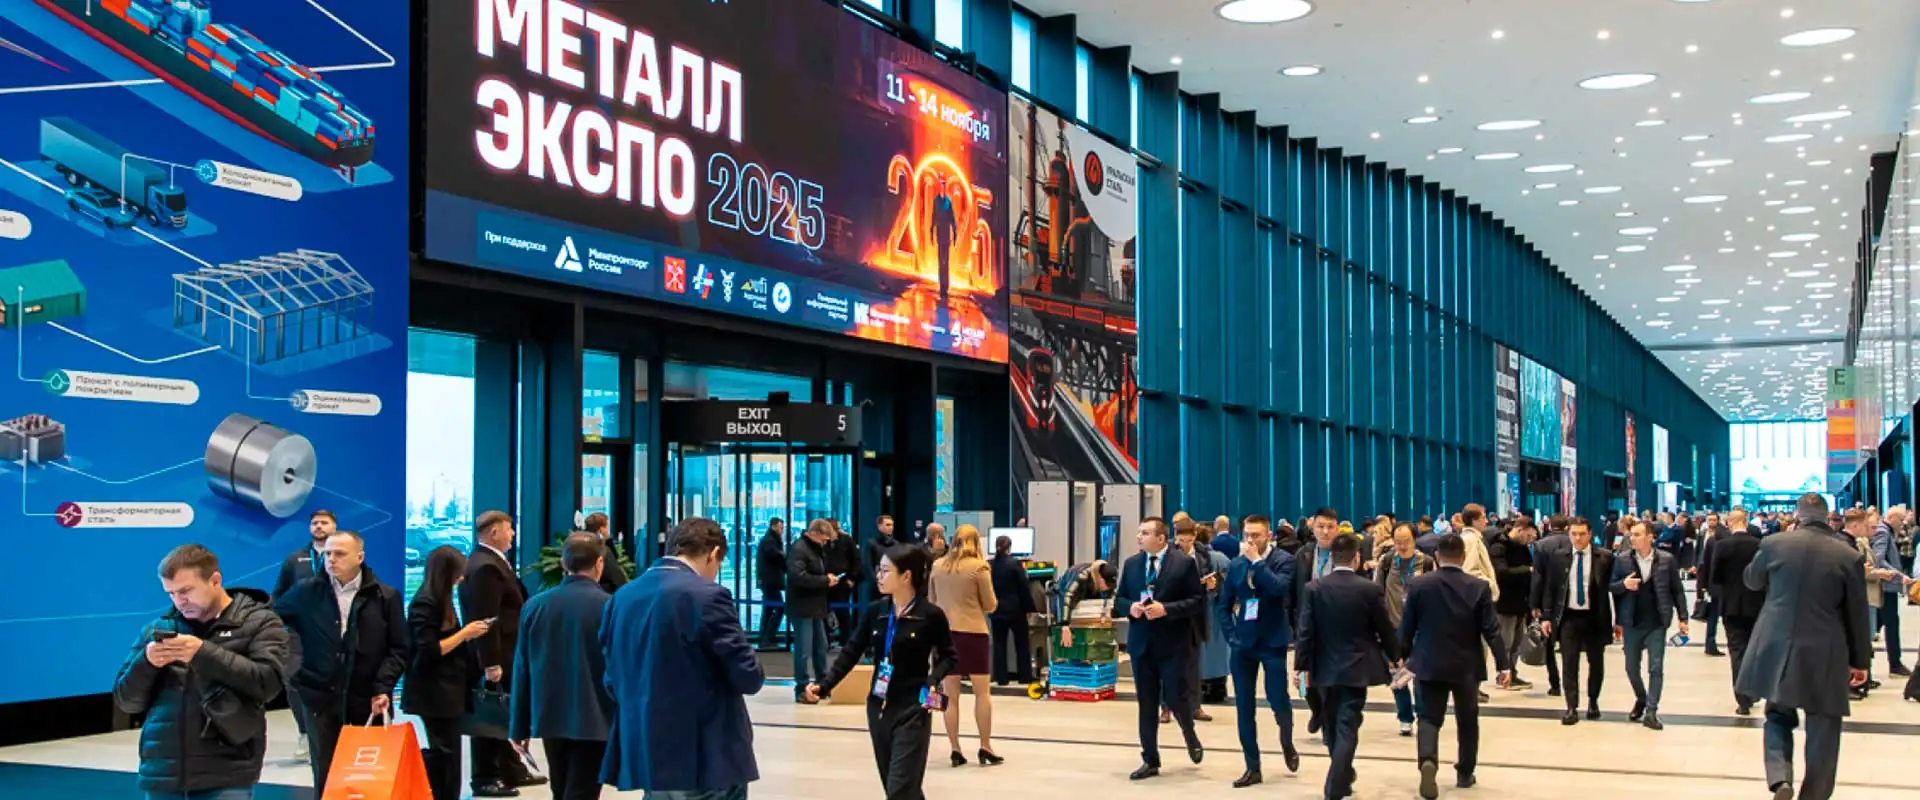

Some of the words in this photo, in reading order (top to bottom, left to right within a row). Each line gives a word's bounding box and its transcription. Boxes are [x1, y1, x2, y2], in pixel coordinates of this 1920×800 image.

[476, 0, 743, 143] МЕТАЛЛ
[886, 73, 905, 104] 11
[919, 87, 938, 118] 14
[941, 103, 991, 142] ноября
[475, 77, 698, 219] ЭКСПО
[707, 151, 826, 252] 2025
[485, 230, 502, 245] При
[588, 247, 650, 270] Минпромторг
[588, 258, 623, 275] России
[75, 375, 113, 387] Прокат
[123, 380, 186, 391] полимерным
[1834, 368, 1846, 386] E
[75, 385, 133, 396] покрытием
[738, 407, 771, 420] EXIT
[726, 422, 782, 437] ВЫХОД
[837, 414, 847, 432] 5
[88, 501, 182, 516] Трансформаторная
[87, 516, 116, 524] сталь
